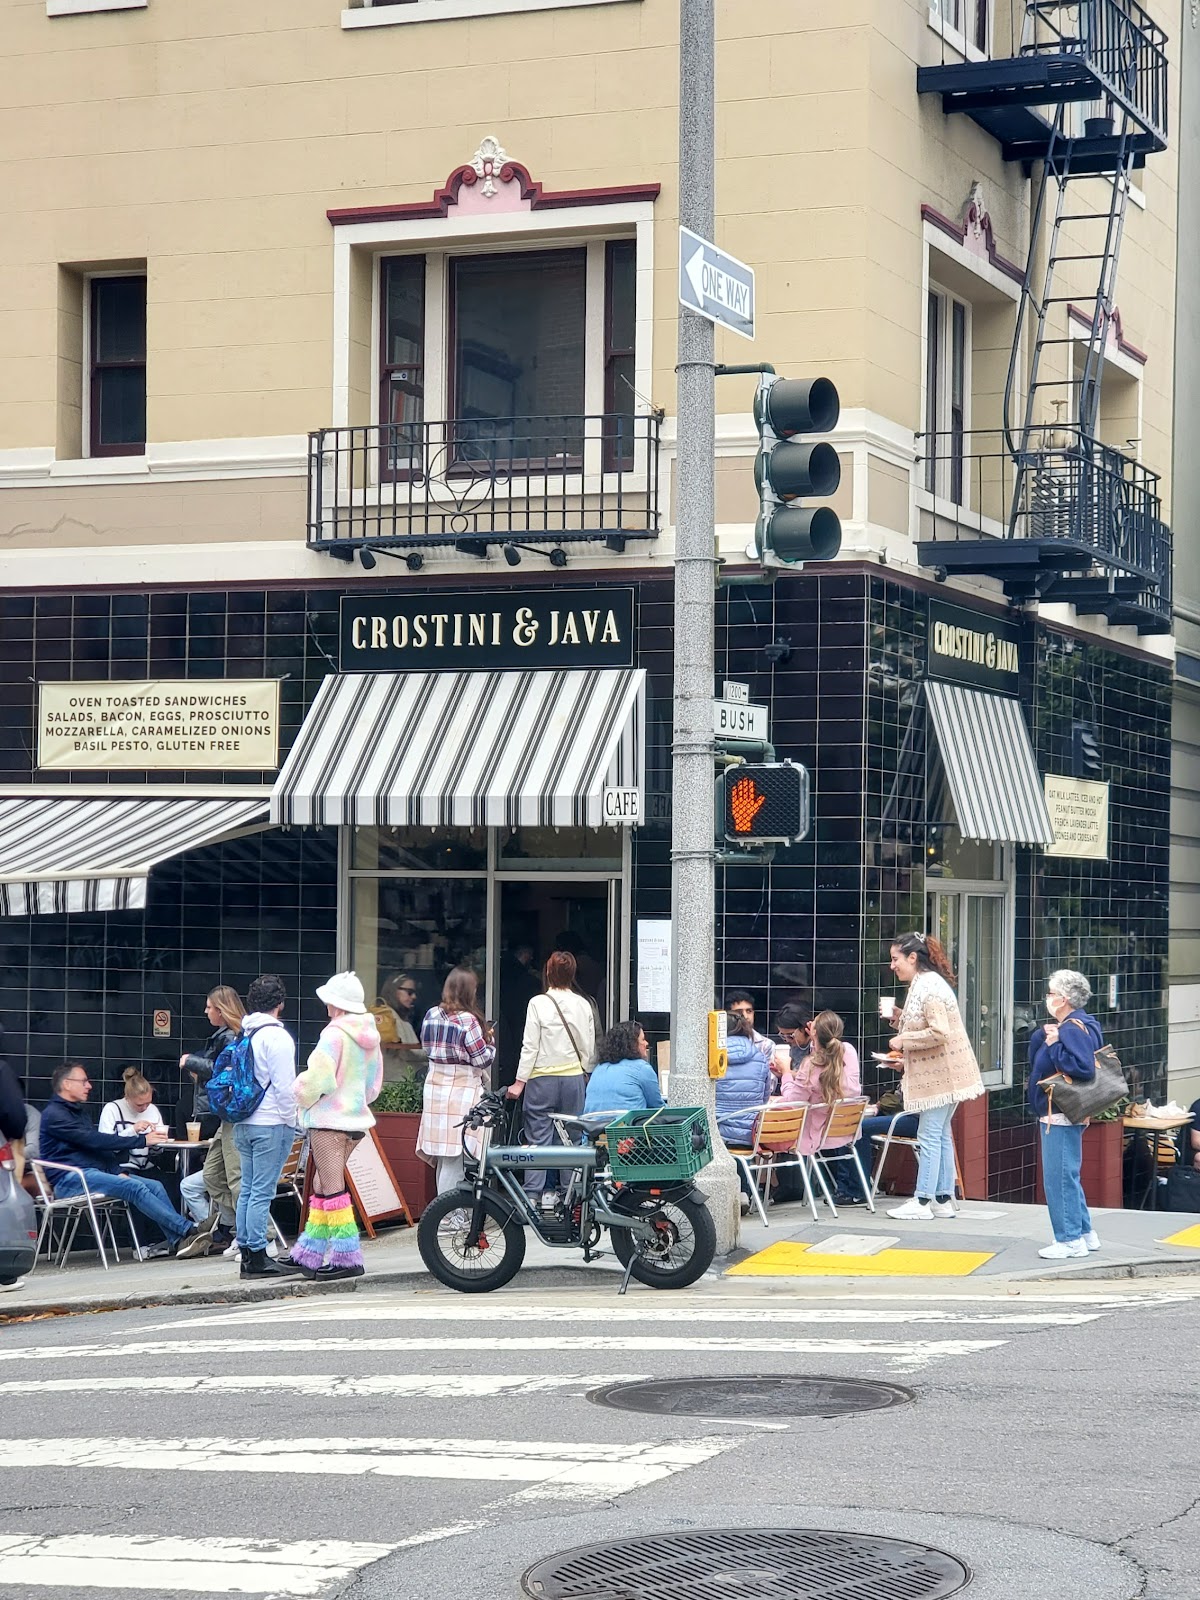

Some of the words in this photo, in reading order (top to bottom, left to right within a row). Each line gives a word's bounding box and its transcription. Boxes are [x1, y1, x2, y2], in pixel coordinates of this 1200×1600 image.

[702, 263, 723, 302] ONE
[726, 276, 748, 314] WAY
[352, 613, 502, 649] CROSTINI
[512, 607, 539, 647] &
[548, 609, 621, 646] JAVA
[934, 621, 985, 665] CROSTINI
[985, 632, 996, 669] &
[996, 638, 1019, 673] JAVA
[69, 697, 102, 707] OVEN
[106, 696, 160, 707] TOASTED
[164, 695, 247, 706] SANDWICHES
[47, 712, 97, 723] SALADS,
[101, 711, 146, 723] BACON,
[149, 711, 185, 722] EGGS,
[189, 710, 270, 721] PROSCIUTTO
[720, 709, 754, 732] BUSH
[45, 726, 128, 737] MOZZARELLA,
[131, 726, 216, 737] CARAMELIZED
[221, 725, 271, 736] ONIONS
[74, 741, 107, 751] BASIL
[111, 741, 152, 752] PESTO,
[156, 740, 206, 751] GLUTEN
[210, 740, 240, 751] FREE
[1057, 791, 1065, 800] MILK
[606, 792, 638, 816] CAFE
[1056, 804, 1070, 814] PEANUT
[1071, 805, 1084, 815] BUTTER
[1054, 817, 1069, 827] FRENCH
[1070, 819, 1087, 829] LAVENDER
[502, 1153, 535, 1164] Rybit
